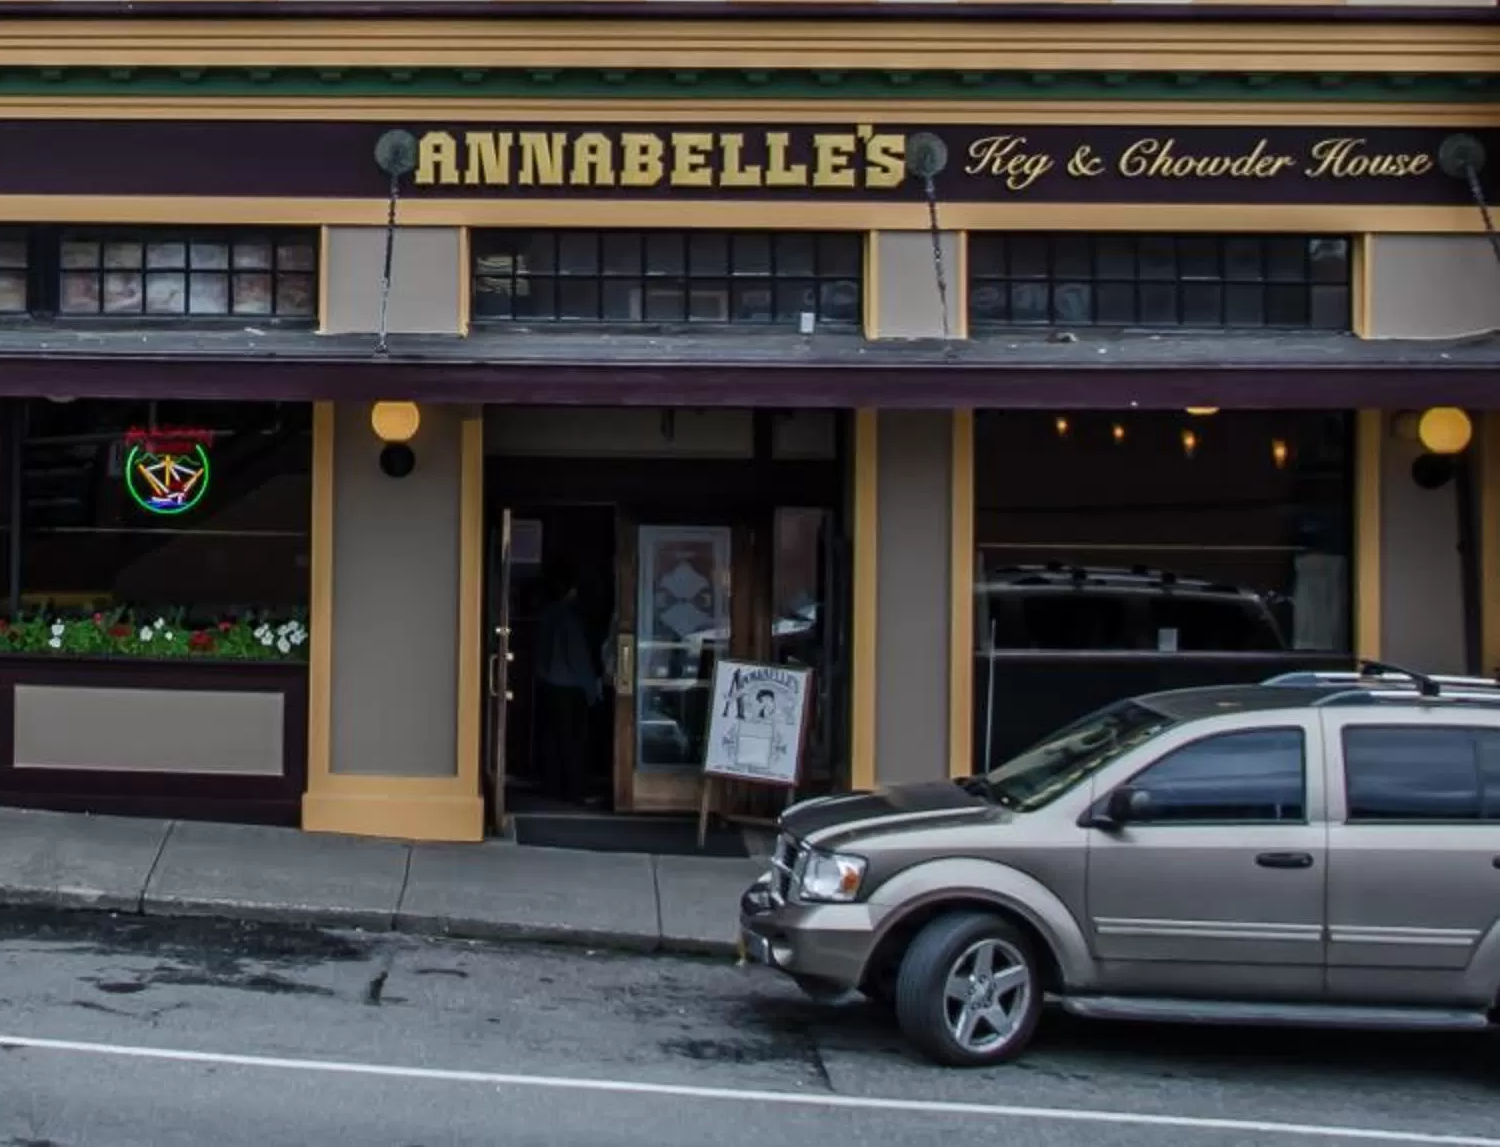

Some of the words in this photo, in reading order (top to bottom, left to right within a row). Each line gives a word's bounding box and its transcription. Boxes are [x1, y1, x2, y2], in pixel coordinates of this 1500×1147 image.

[414, 124, 907, 188] ANNABELLE'S
[964, 135, 1054, 190] Keg
[1066, 144, 1106, 178] &
[1118, 138, 1297, 178] Chowder
[1304, 137, 1434, 178] House
